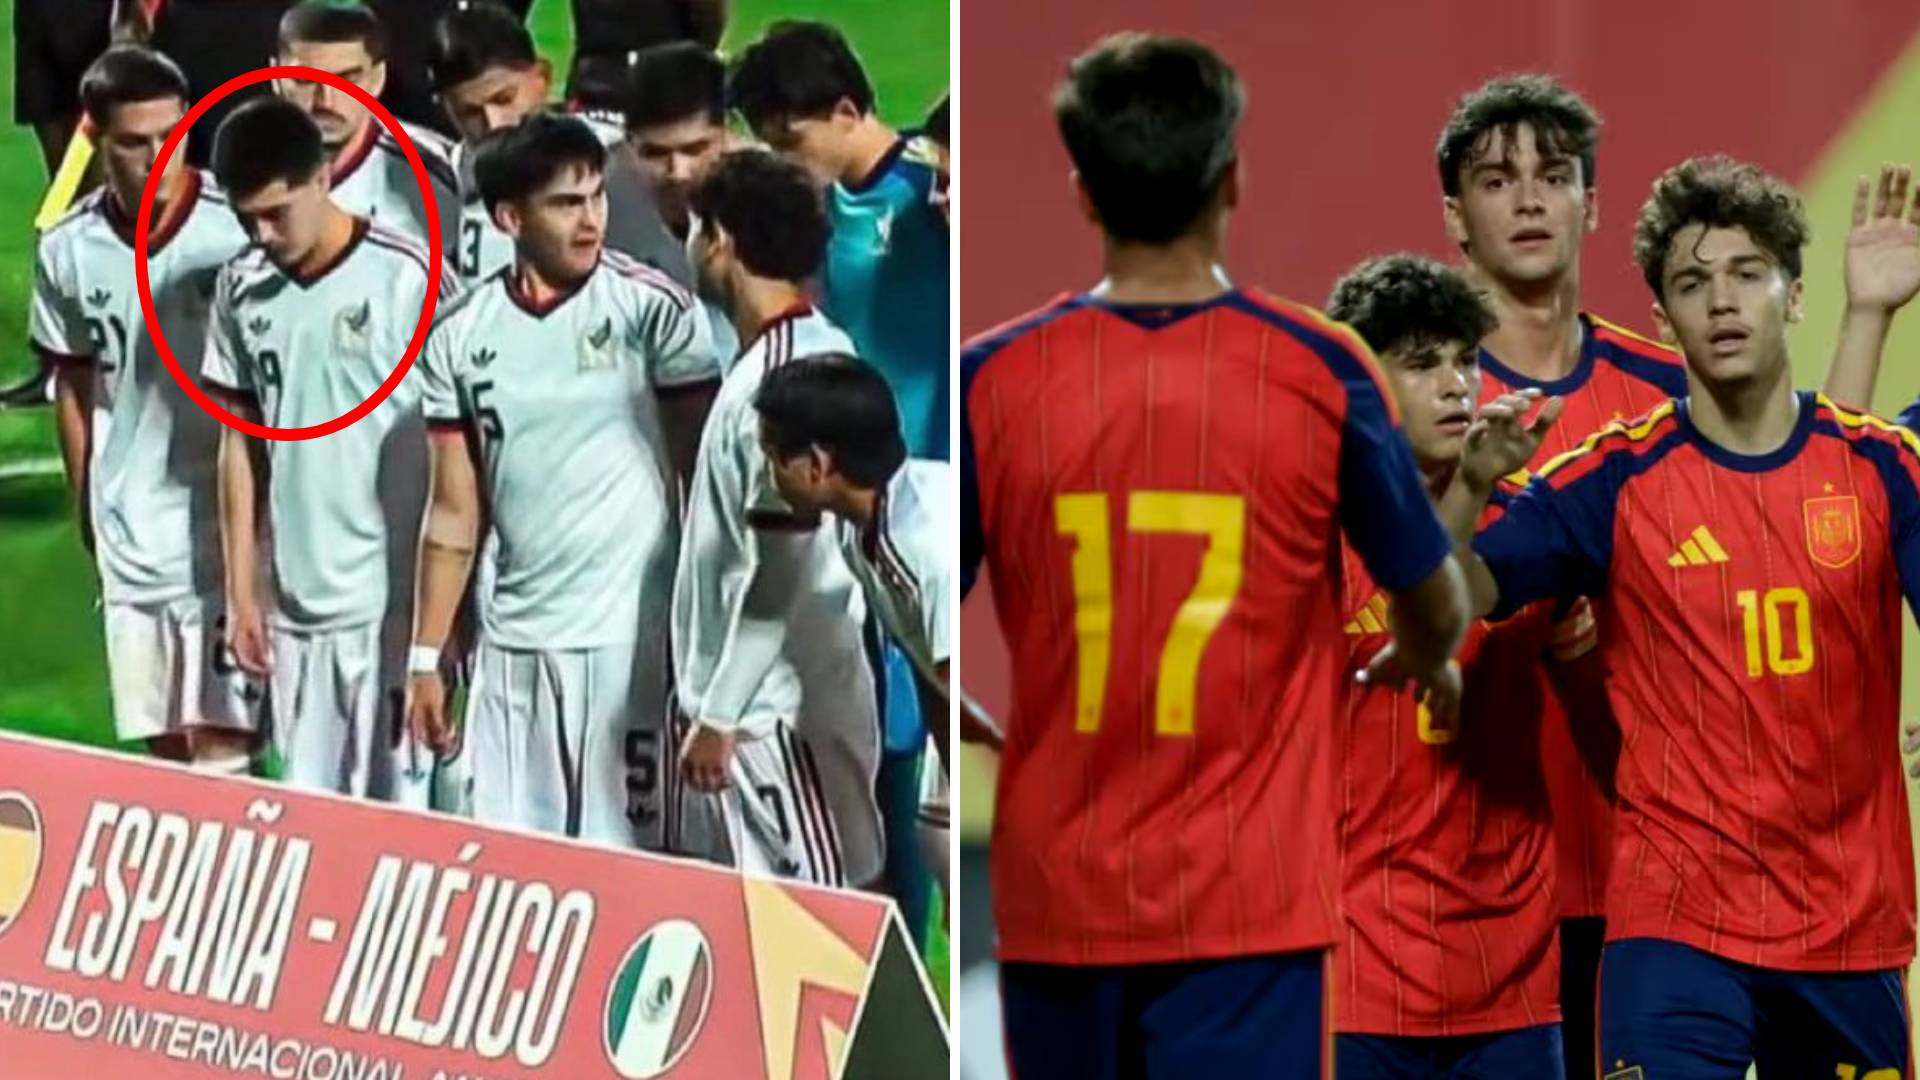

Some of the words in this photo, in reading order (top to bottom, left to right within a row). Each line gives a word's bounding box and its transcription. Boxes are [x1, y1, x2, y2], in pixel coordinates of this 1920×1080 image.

[462, 218, 482, 277] 3
[472, 380, 505, 442] 5
[1053, 489, 1246, 738] 17
[1736, 586, 1815, 678] 10
[625, 729, 658, 791] 5
[756, 784, 791, 844] 7
[45, 798, 312, 1011] ESPAÑA
[323, 841, 596, 1067] MÉJICO
